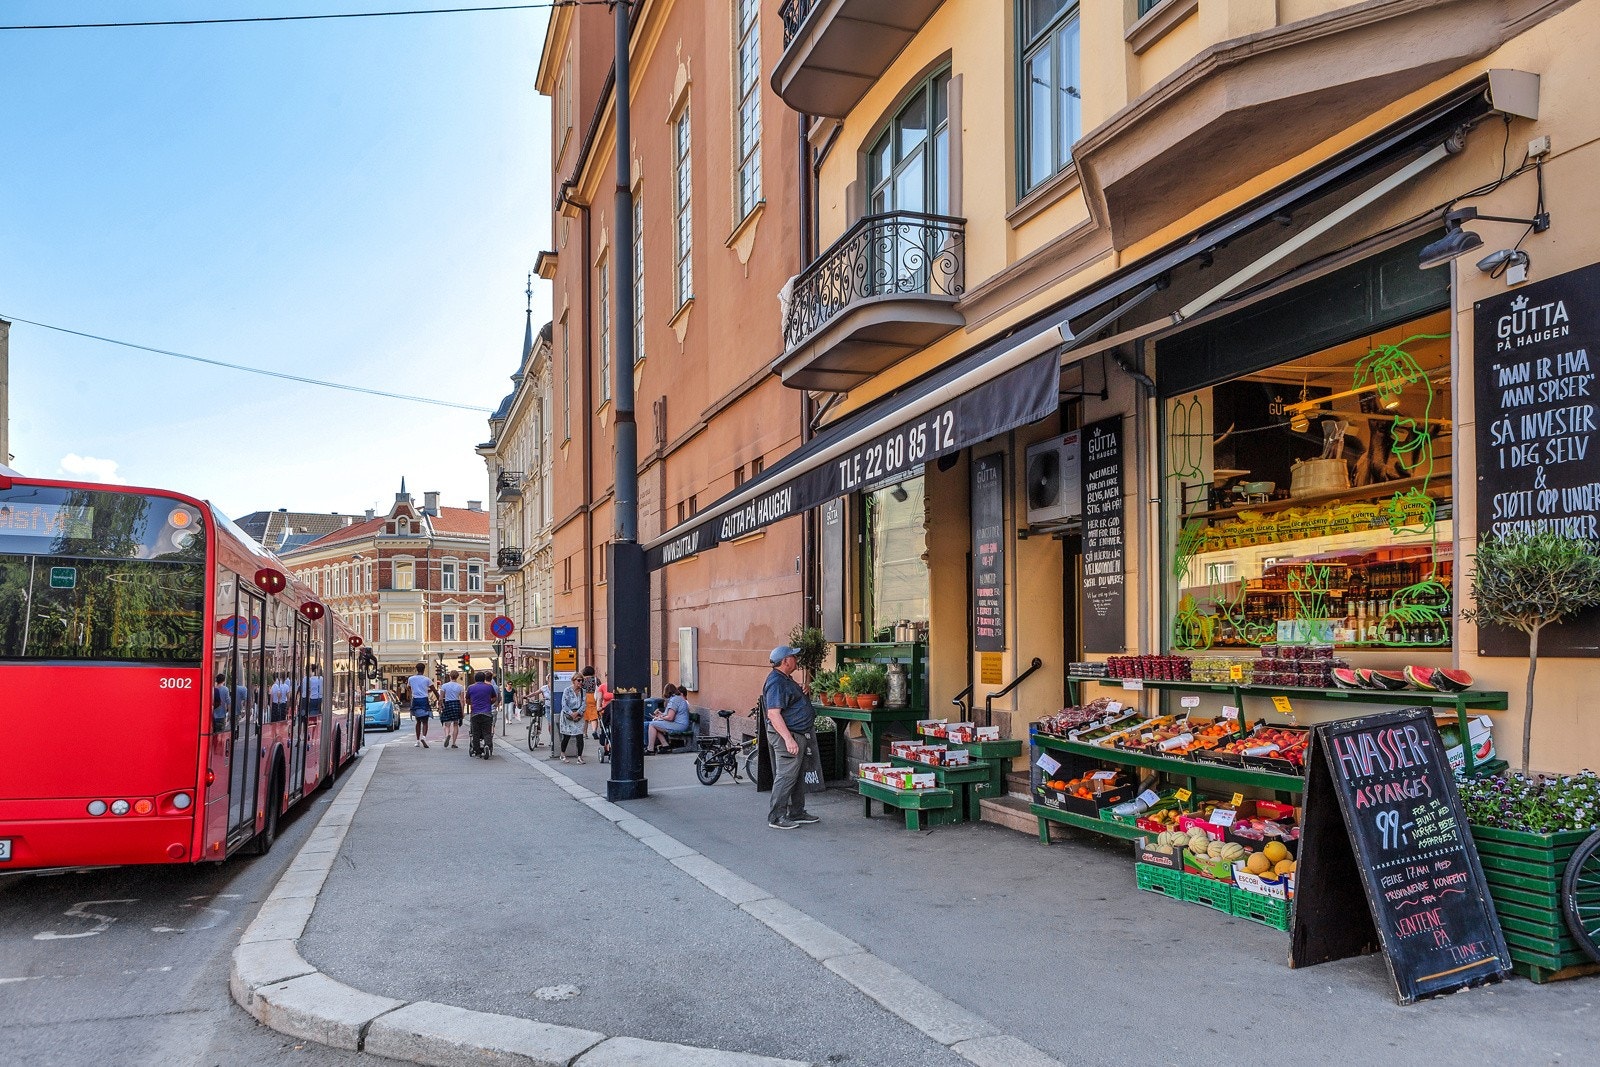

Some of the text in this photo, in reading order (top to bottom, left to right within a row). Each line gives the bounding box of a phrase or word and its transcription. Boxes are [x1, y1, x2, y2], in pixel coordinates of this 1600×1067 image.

[1497, 300, 1569, 339] GUTTA
[1497, 325, 1569, 352] PÅ HAUGEN
[1536, 357, 1553, 380] ER
[1557, 348, 1590, 376] HVA
[1500, 384, 1534, 409] MAN
[1490, 404, 1597, 447] SÅ INVESTER
[839, 410, 954, 491] TLF. 22 60 85 12
[1088, 432, 1117, 453] GUTTA
[1096, 448, 1117, 460] HAUGEN
[1499, 435, 1589, 470] I DEG SELV
[977, 467, 998, 483] GUTTA
[1534, 465, 1547, 490] &
[1104, 486, 1119, 499] MEN
[1492, 482, 1600, 520] STØTT OPP UNDER
[721, 487, 792, 539] GUTTA PÅ HAUGEN
[1087, 516, 1120, 530] HER ER GOD
[1098, 528, 1109, 537] FOR
[1088, 538, 1097, 547] OG
[1085, 550, 1093, 563] SÅ
[1084, 559, 1121, 576] VELKOMMEN
[1098, 576, 1107, 586] DU
[159, 677, 193, 689] 3002
[1356, 775, 1432, 809] ASPARGES
[1412, 798, 1440, 816] FOR EN
[1415, 806, 1450, 827] BUNT MED
[1411, 823, 1438, 840] NORGES
[1434, 860, 1452, 872] MED
[1238, 874, 1259, 886] ESCOBI
[1432, 872, 1467, 889] KONFEKT
[1394, 907, 1446, 938] JENTENE
[1446, 940, 1487, 961] TUNET
